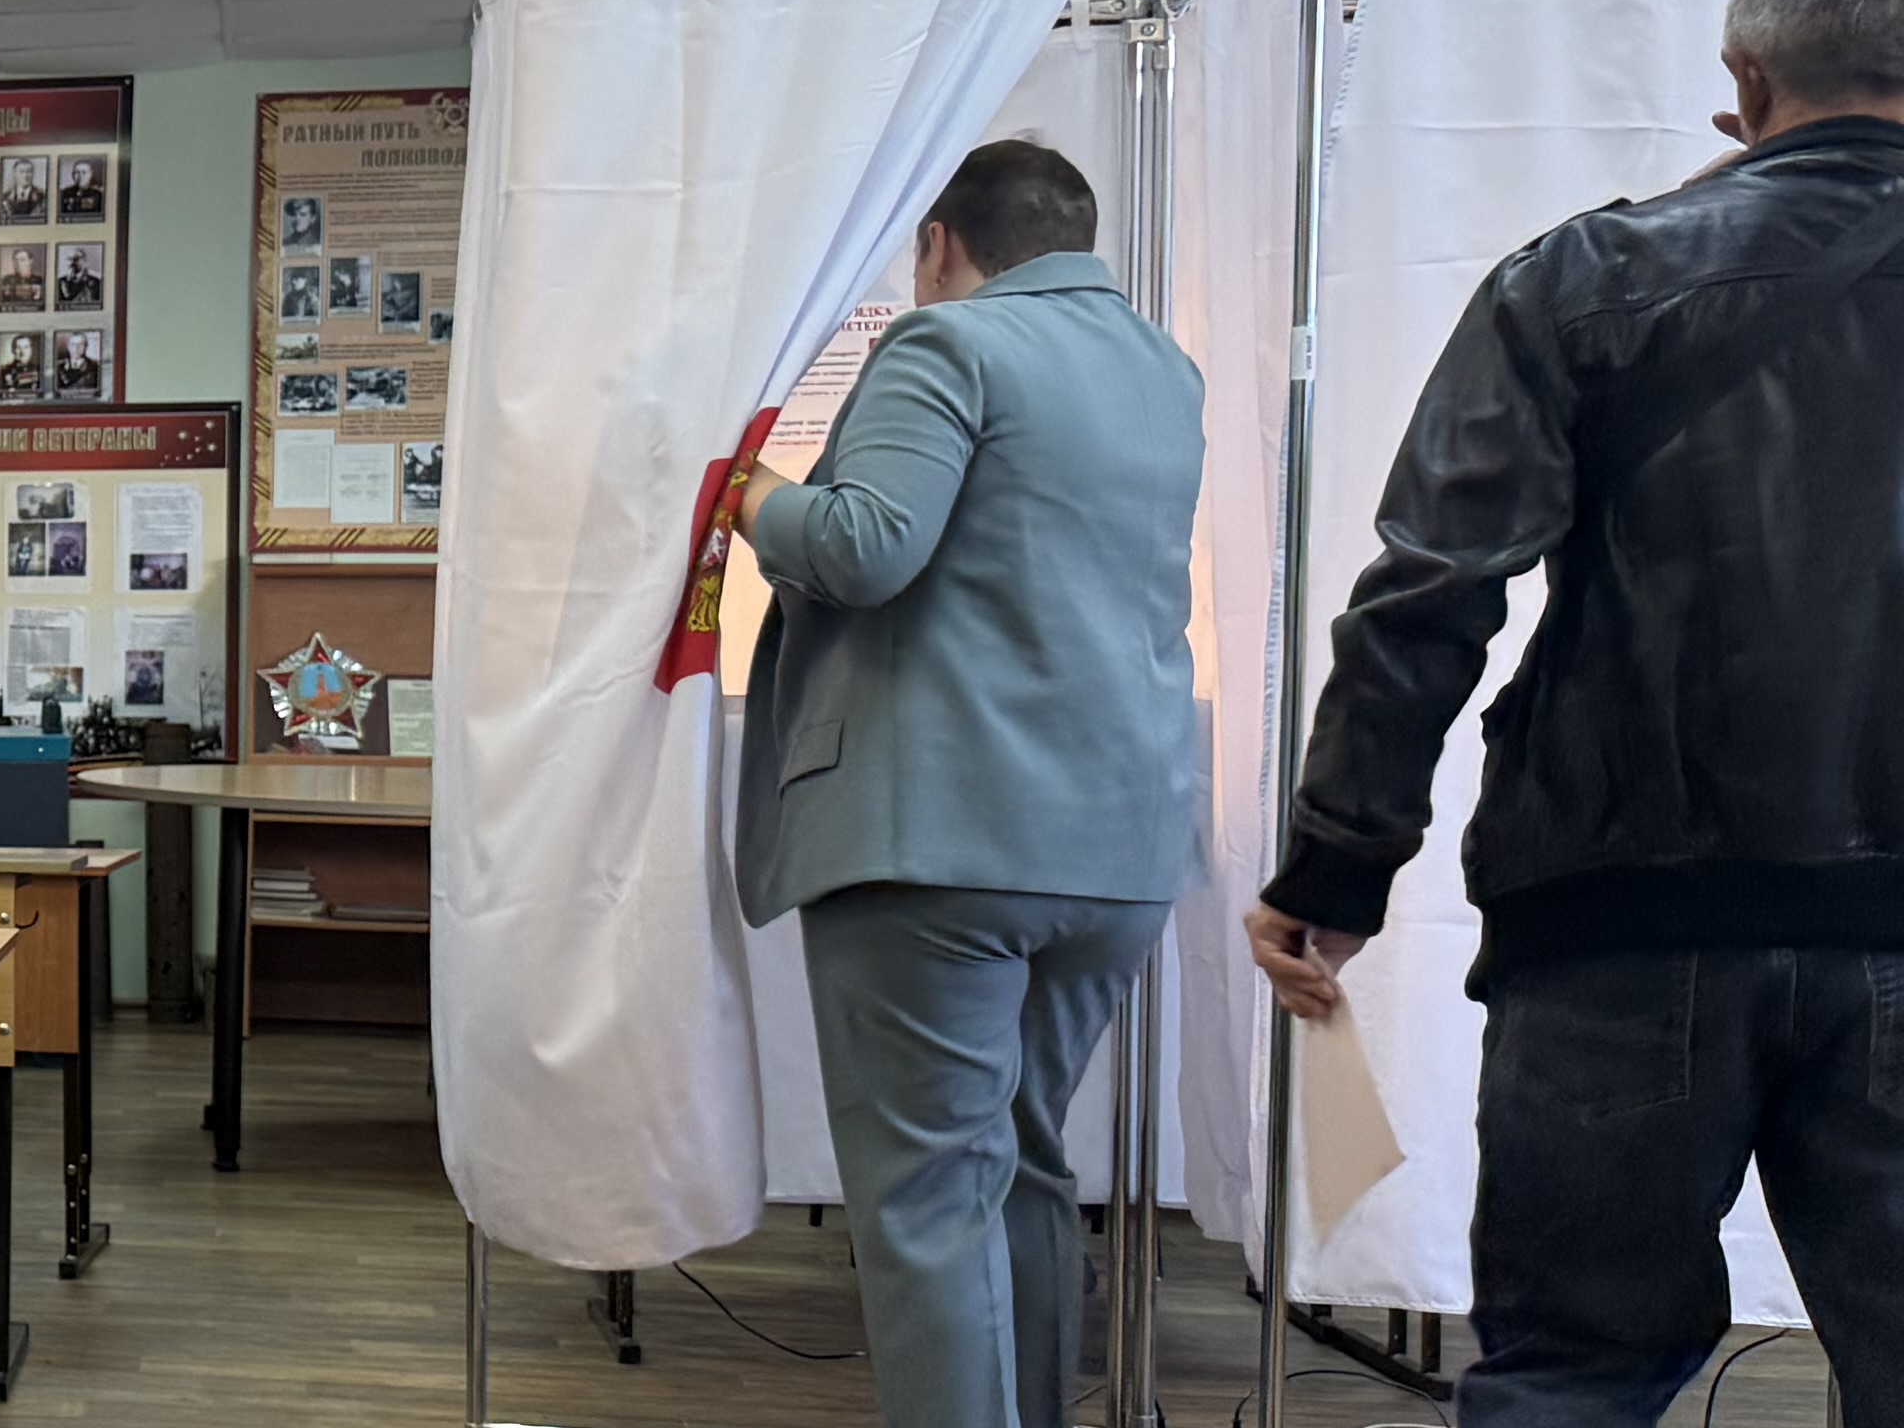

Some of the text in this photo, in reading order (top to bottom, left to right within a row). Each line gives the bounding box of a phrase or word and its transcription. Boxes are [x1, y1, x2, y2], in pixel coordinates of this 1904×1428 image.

[282, 122, 420, 144] РАТНЫЙ ПУТЬ
[33, 426, 157, 452] ВЕТЕРАНЫ
